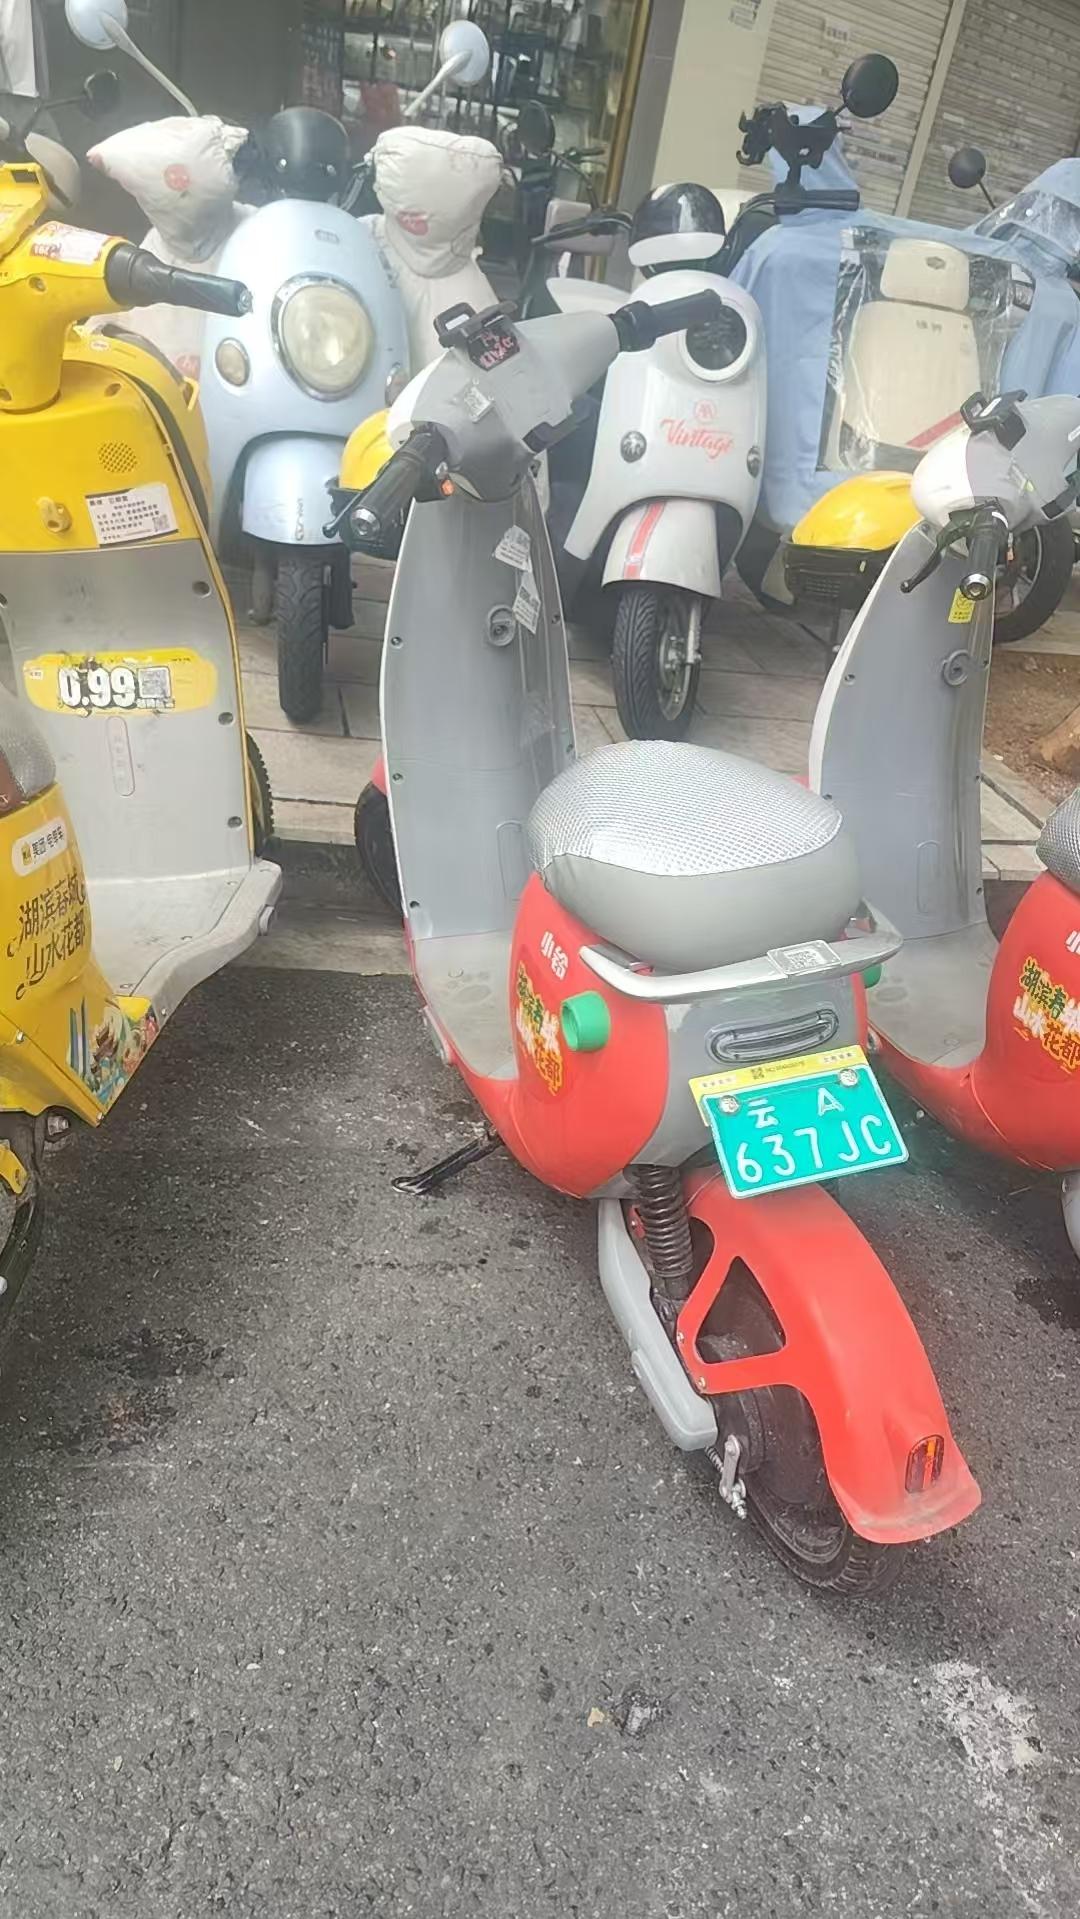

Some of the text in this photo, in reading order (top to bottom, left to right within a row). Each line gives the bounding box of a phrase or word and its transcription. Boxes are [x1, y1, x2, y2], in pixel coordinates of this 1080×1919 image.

[659, 419, 735, 459] Vintage
[57, 665, 137, 710] 0.99
[746, 1087, 845, 1129] 云 A
[735, 1114, 892, 1184] 637JC
